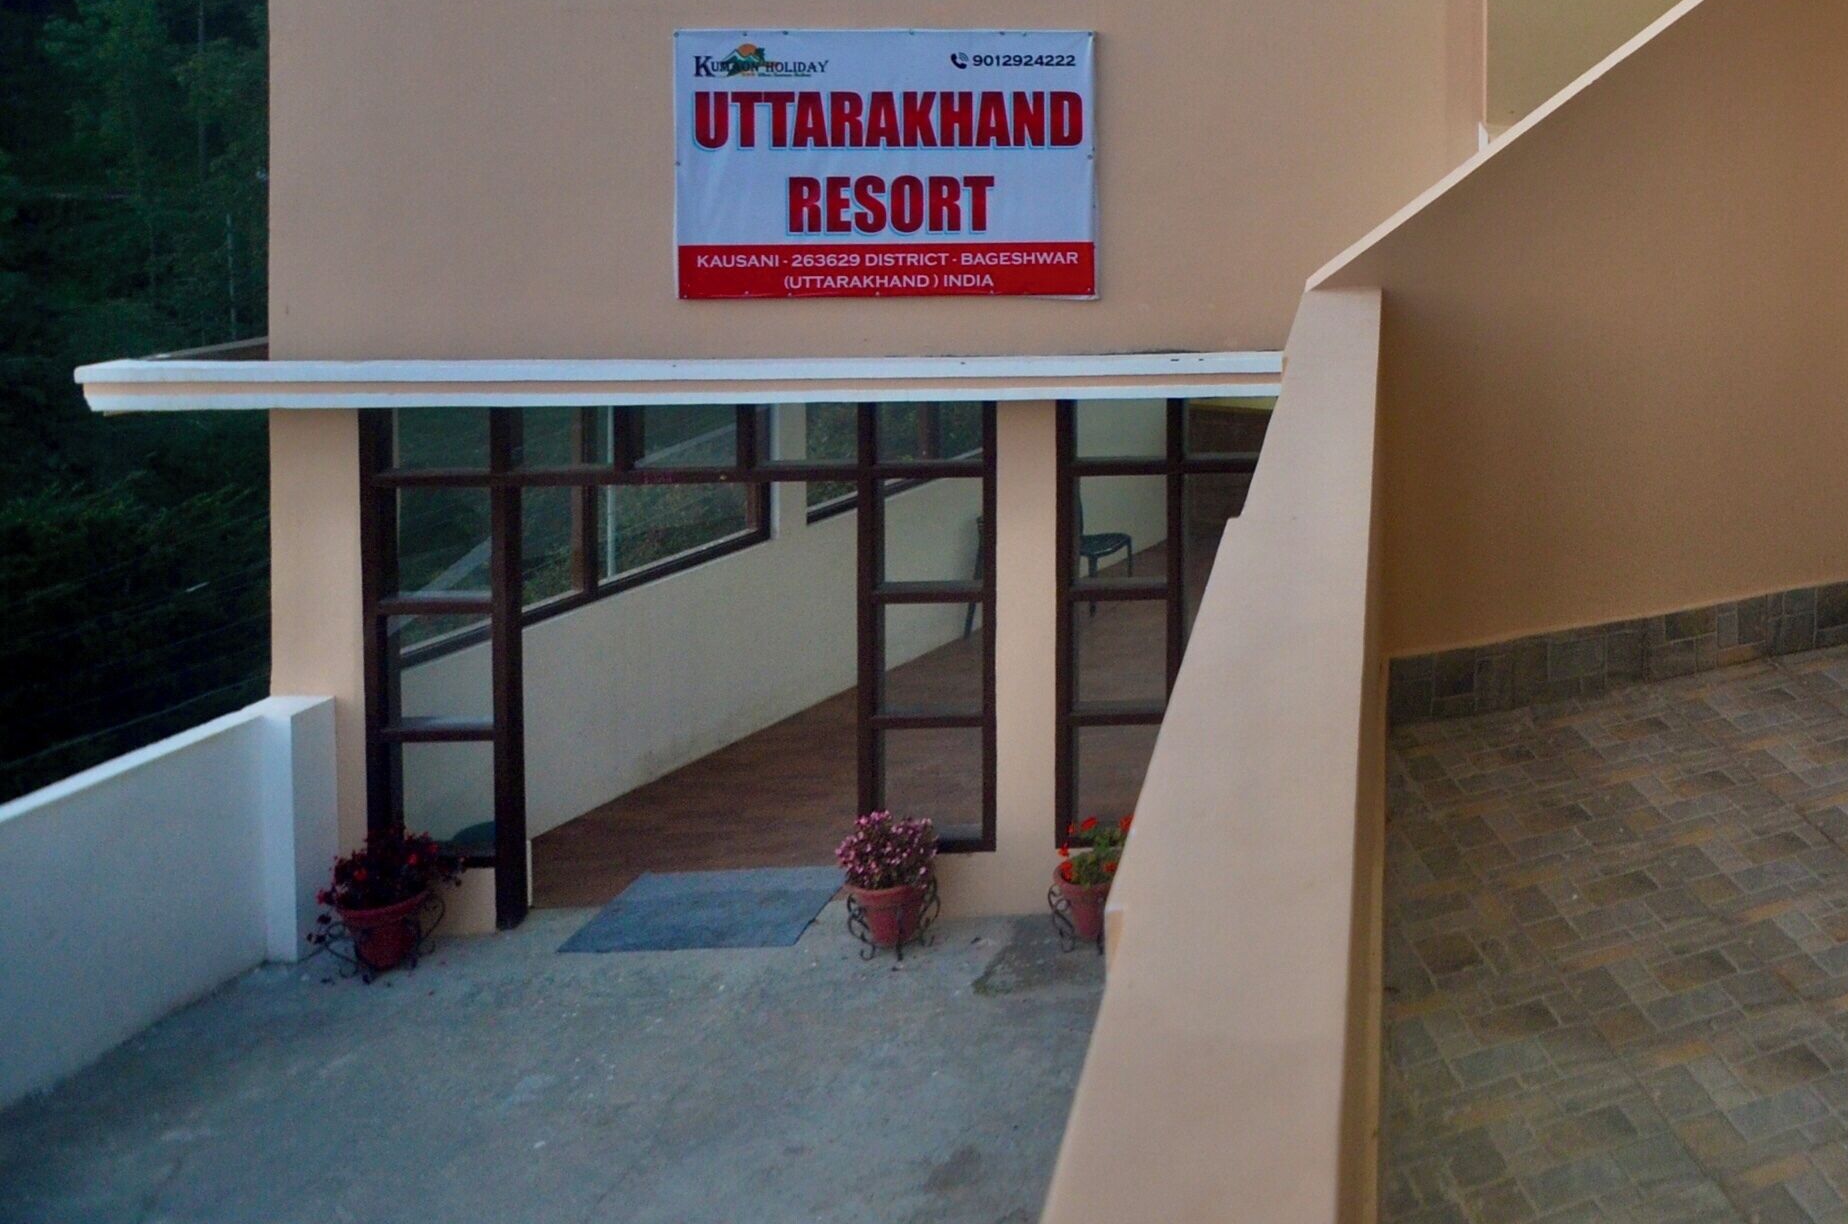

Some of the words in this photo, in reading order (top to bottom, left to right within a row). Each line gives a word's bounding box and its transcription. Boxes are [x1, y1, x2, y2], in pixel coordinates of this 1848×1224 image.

[766, 60, 829, 73] HOLIDAY
[972, 54, 1076, 67] 9012924222
[694, 91, 1083, 148] UTTARAKHAND
[788, 175, 995, 233] RESORT
[697, 255, 779, 268] KAUSANI
[791, 254, 861, 267] 263629
[865, 253, 949, 266] DISTRICT
[961, 251, 1079, 265] BAGESHWAR
[943, 274, 994, 287] INDIA
